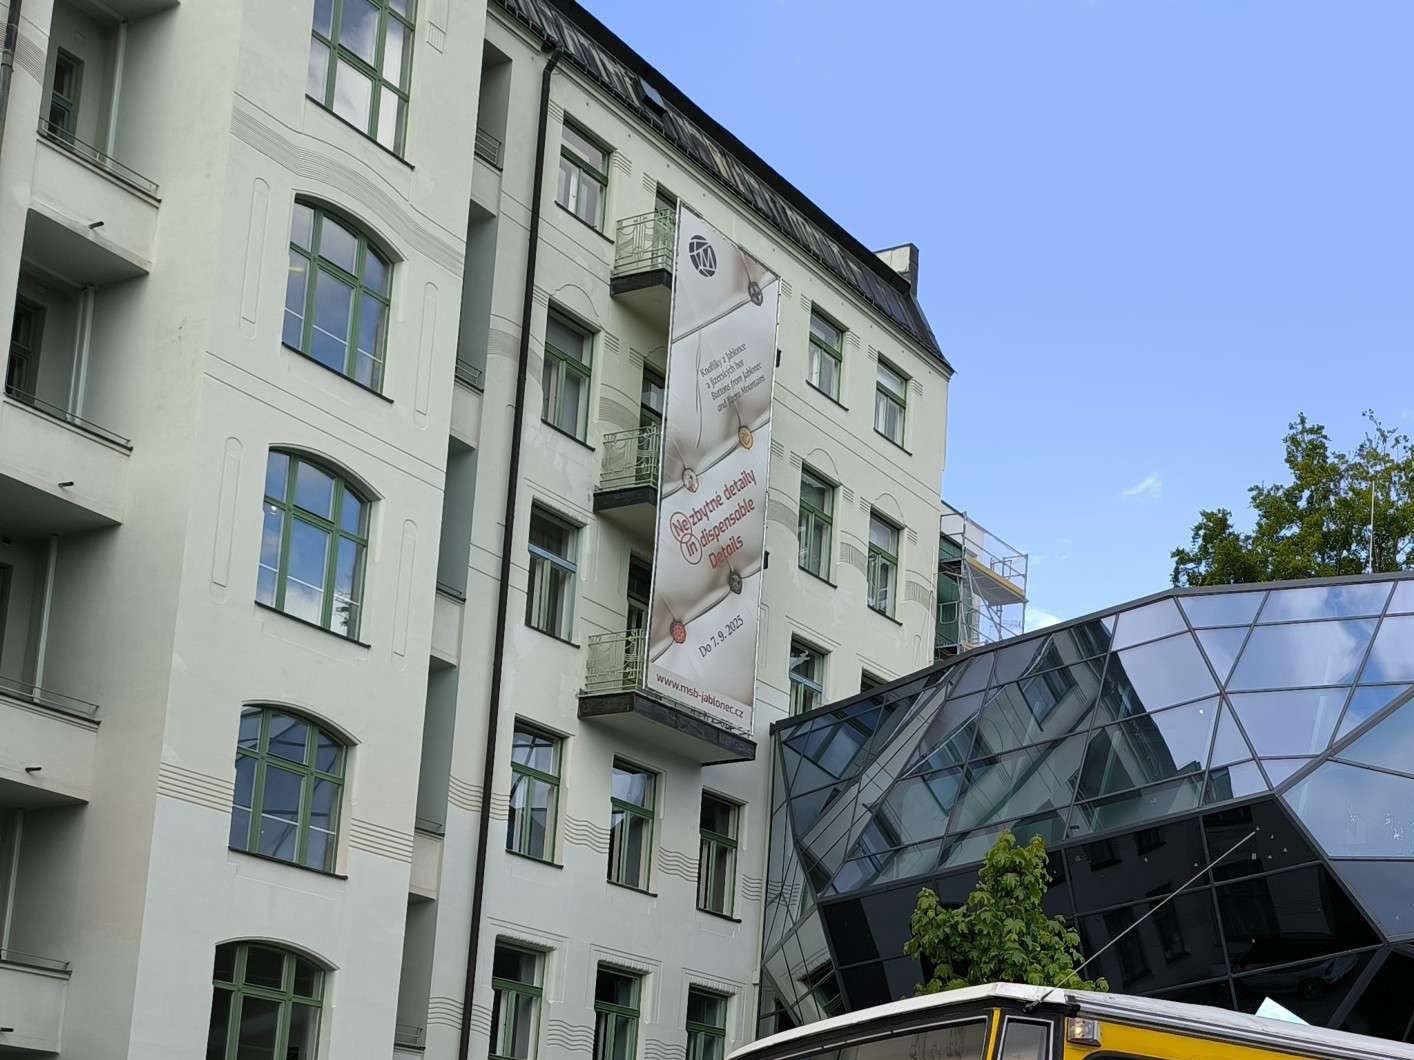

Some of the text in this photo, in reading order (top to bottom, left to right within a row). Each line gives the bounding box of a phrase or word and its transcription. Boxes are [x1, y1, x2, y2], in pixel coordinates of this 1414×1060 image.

[723, 469, 757, 500] detaily
[708, 535, 744, 568] Details
[698, 644, 712, 658] Do
[725, 614, 744, 636] 2025
[656, 673, 744, 718] www.msb-jablonec.cz
